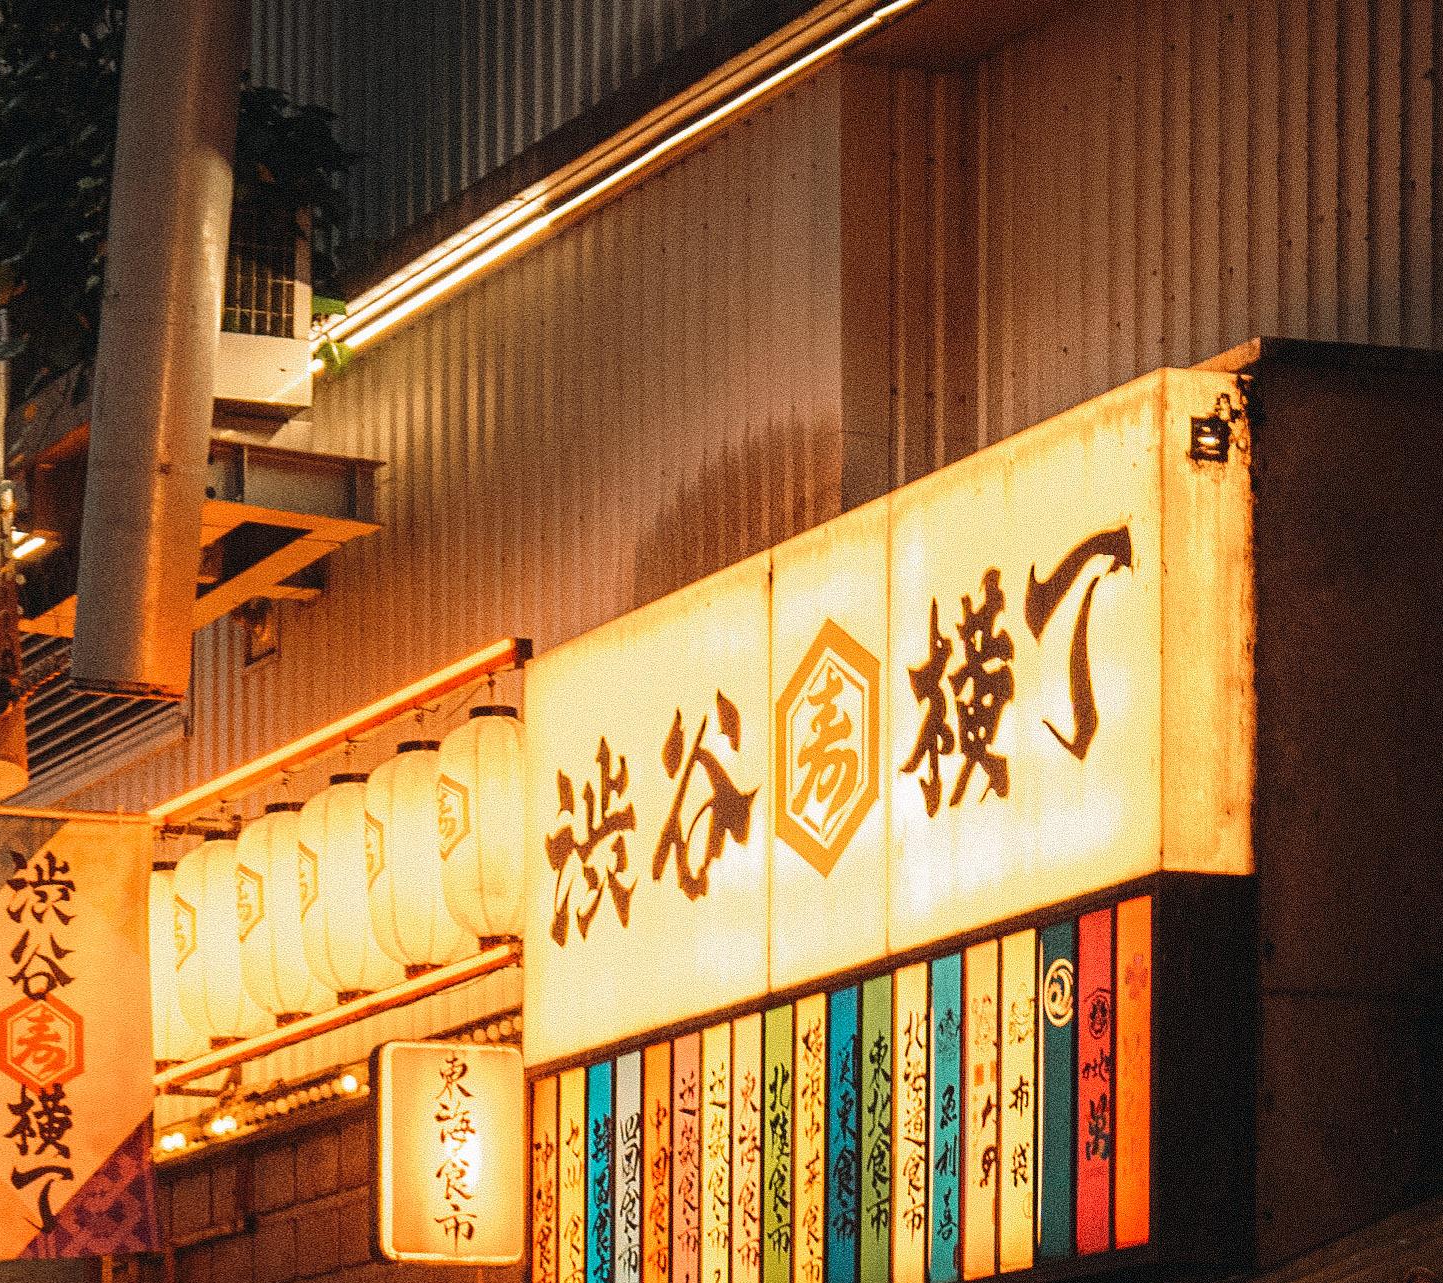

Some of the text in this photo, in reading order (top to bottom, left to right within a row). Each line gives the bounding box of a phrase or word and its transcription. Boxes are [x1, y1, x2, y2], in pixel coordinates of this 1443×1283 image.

[545, 690, 760, 948] 渋谷
[899, 524, 1133, 818] 横丁
[7, 850, 76, 1000] 渋谷
[4, 1084, 75, 1232] 横丁
[434, 1054, 478, 1252] 東海食市
[618, 1111, 641, 1280] 四国食市
[649, 1099, 670, 1277] 中国食市
[737, 1066, 761, 1272] 東海食市
[767, 1062, 791, 1256] 北陸食市
[866, 1029, 892, 1242] 東北食市
[903, 1010, 927, 1242] 北海道食市
